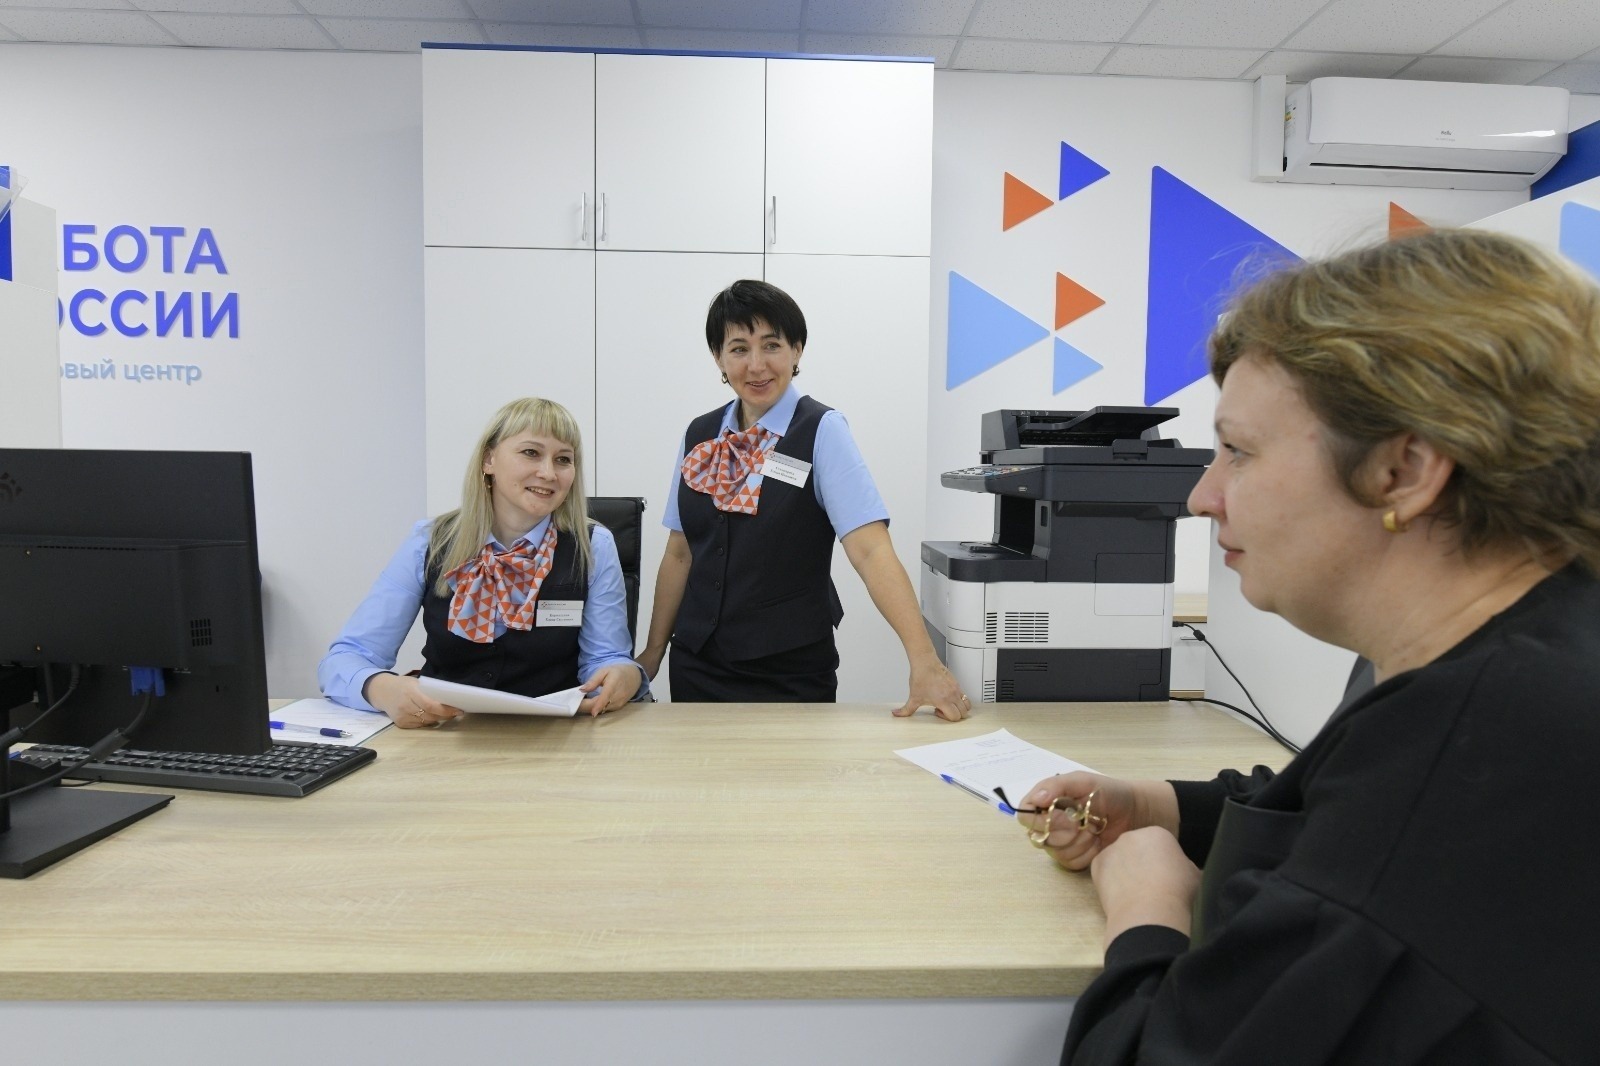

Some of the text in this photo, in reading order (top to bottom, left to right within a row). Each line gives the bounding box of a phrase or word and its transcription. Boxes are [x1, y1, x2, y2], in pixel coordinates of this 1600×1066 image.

[62, 224, 227, 274] БОТА
[58, 288, 239, 338] ССИИ
[60, 358, 202, 386] вый центр
